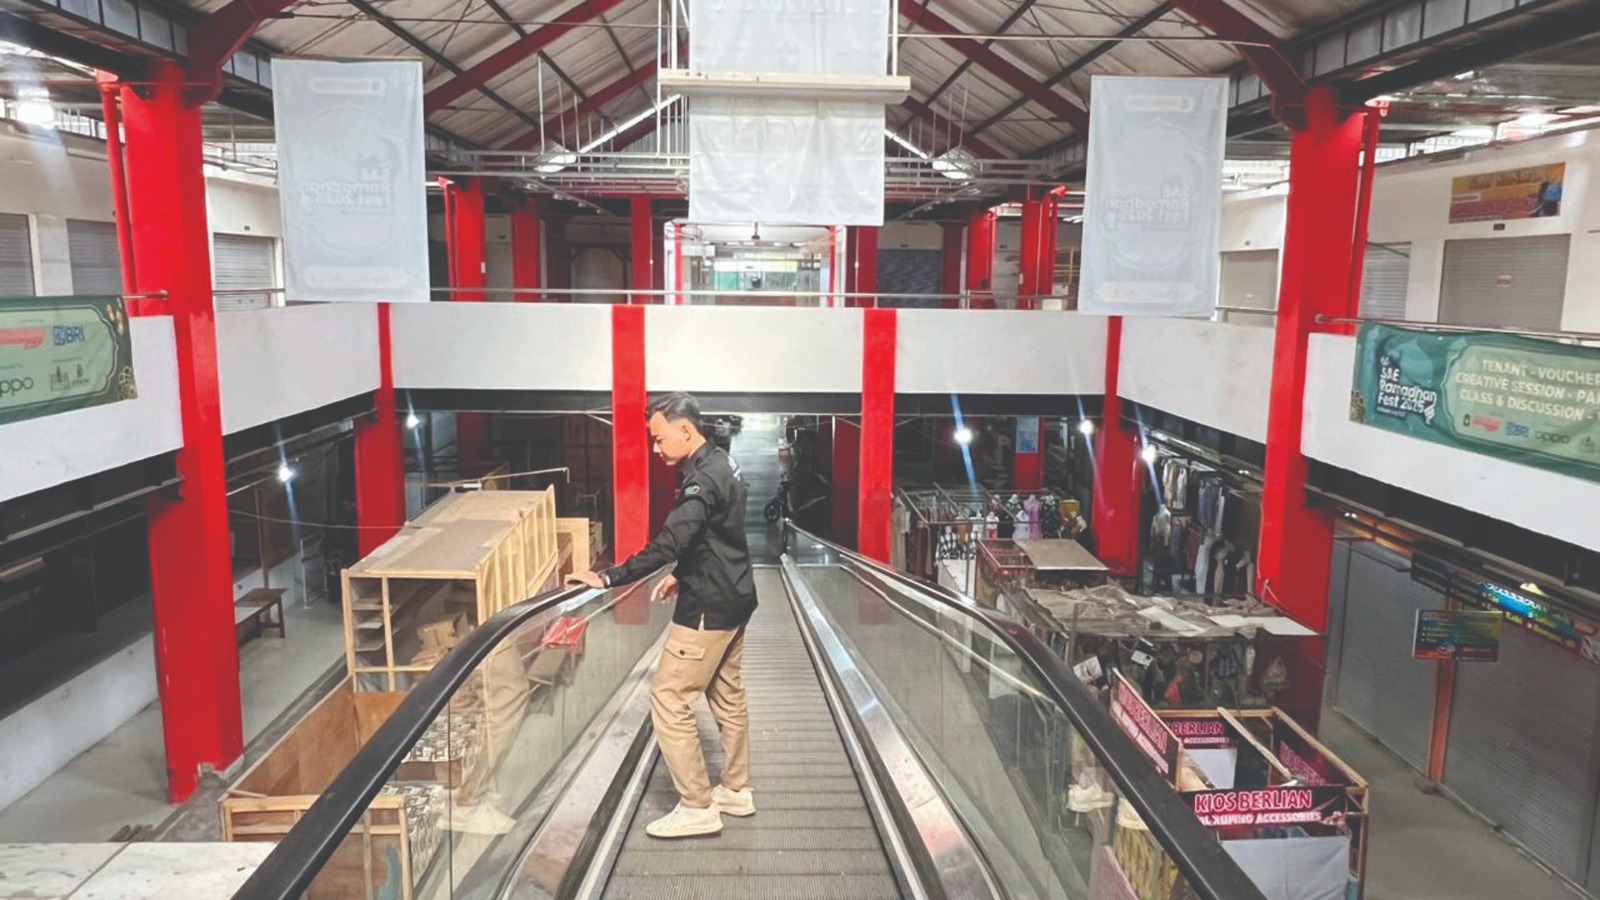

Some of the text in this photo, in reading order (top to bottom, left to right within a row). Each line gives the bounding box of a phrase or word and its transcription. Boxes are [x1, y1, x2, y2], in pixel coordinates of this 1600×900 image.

[1380, 367, 1400, 382] SAE
[1482, 359, 1529, 377] TENANT
[1379, 379, 1437, 403] Ramadhan
[1456, 372, 1509, 391] CREATIVE
[1512, 380, 1565, 399] SESSION
[1378, 392, 1400, 408] Fest
[1400, 396, 1426, 414] 2025
[1460, 388, 1494, 405] CLASS
[1507, 396, 1585, 420] DISCUSSION
[1172, 721, 1225, 736] BERLIAN
[1195, 790, 1313, 813] KIOS BERLIAN
[1255, 812, 1323, 825] ACCESSORIES
